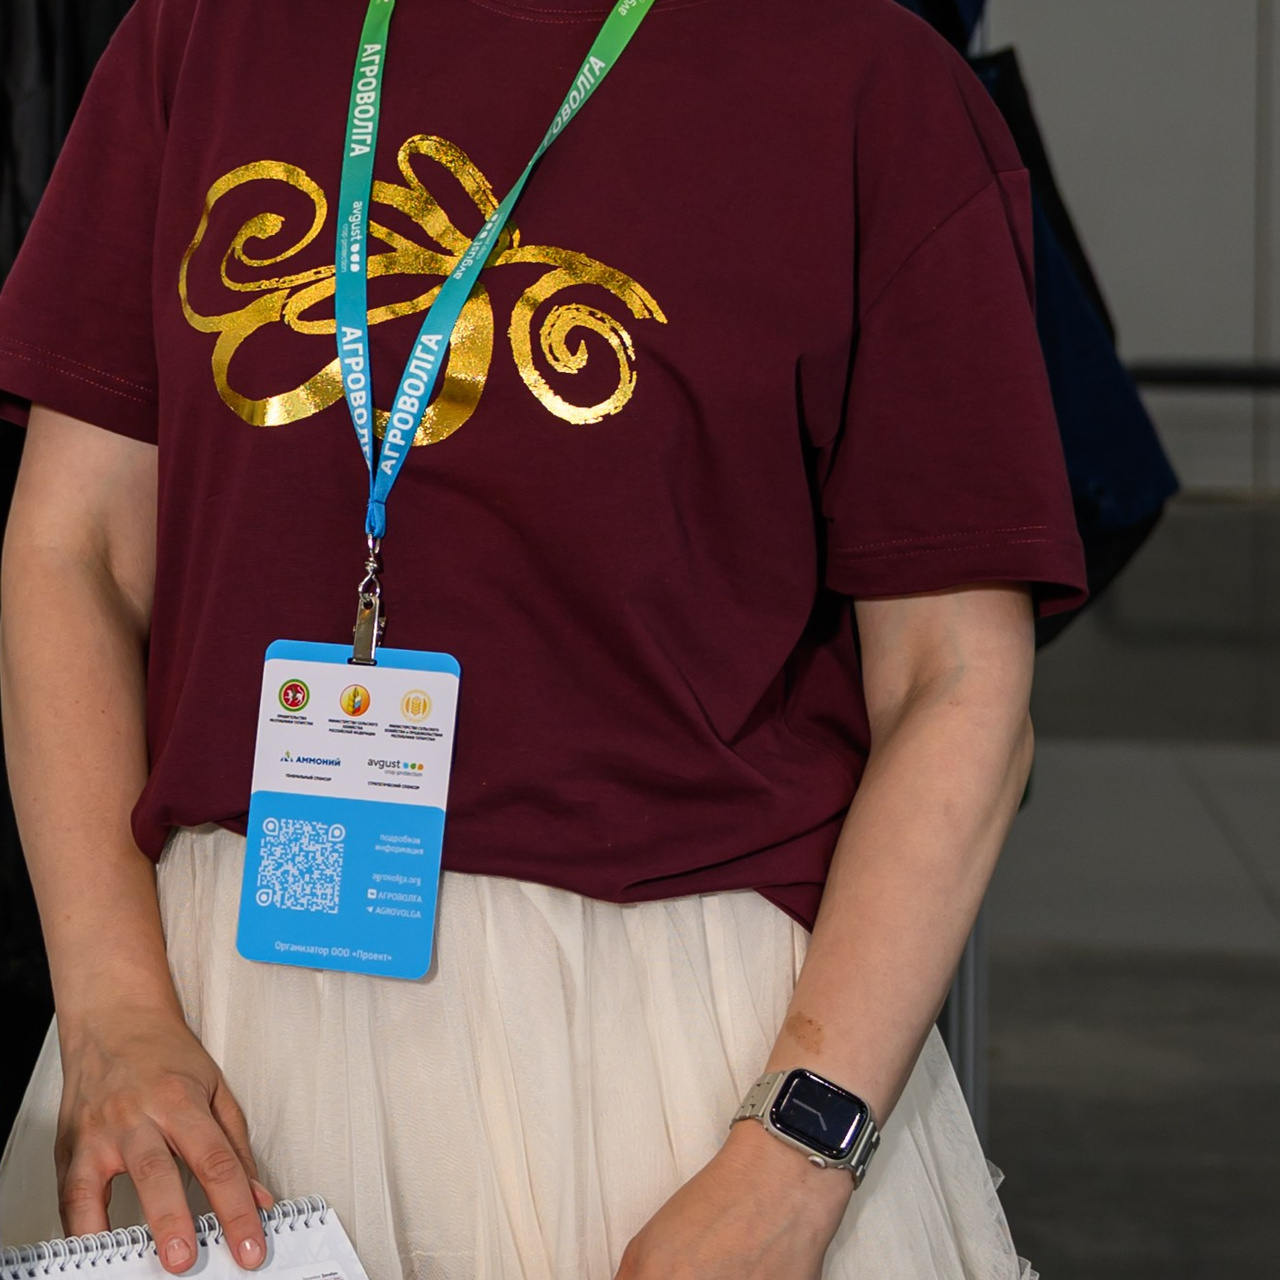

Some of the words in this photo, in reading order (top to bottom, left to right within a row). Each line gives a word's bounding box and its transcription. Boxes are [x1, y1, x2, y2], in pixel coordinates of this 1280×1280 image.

[349, 43, 381, 157] АГРОВОЛГА
[543, 55, 606, 146] ОВОЛГА
[348, 201, 363, 242] avgust
[453, 241, 483, 279] avgust
[341, 326, 370, 470] АГРОВОЛ
[381, 334, 443, 475] АГРОВОЛГА
[295, 756, 341, 767] АММОНИЙ
[368, 758, 400, 769] avgust
[372, 873, 421, 886] agrovolga.org
[378, 891, 422, 903] АГРОВОЛГА
[375, 906, 421, 918] AGROVOLGA
[275, 941, 329, 956] Организатор
[331, 947, 350, 957] ООО
